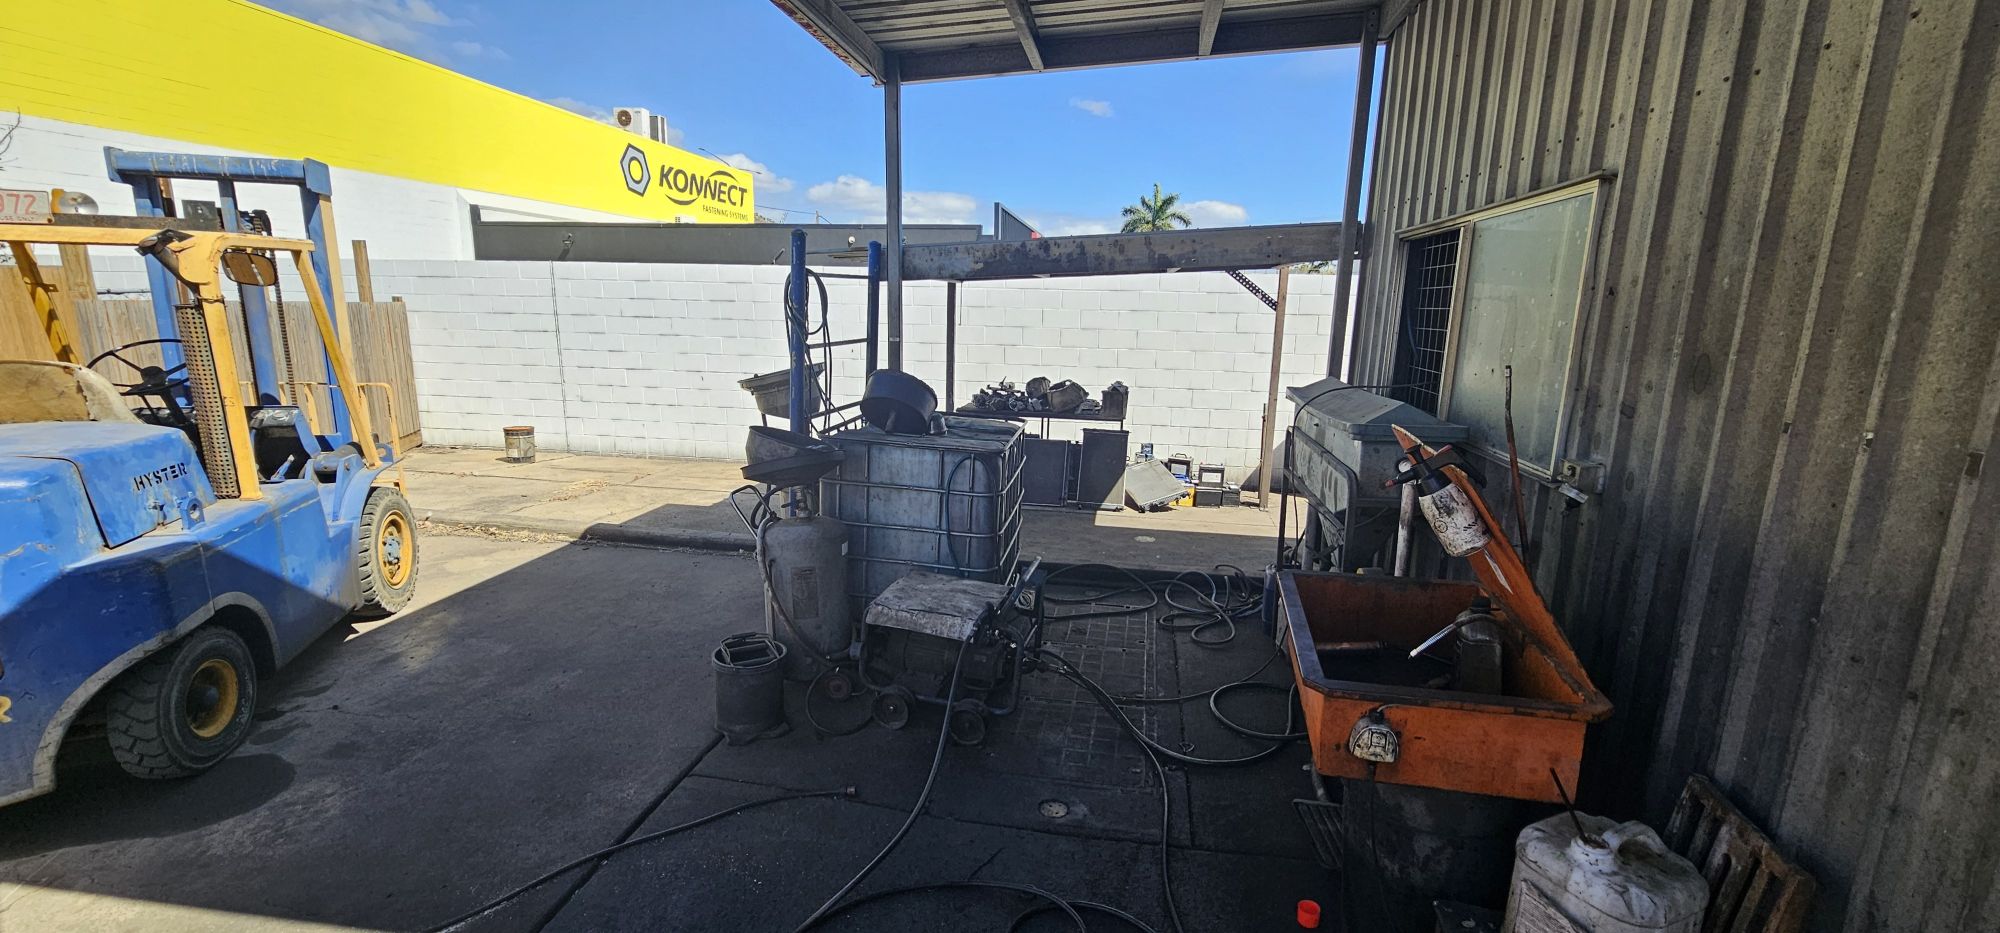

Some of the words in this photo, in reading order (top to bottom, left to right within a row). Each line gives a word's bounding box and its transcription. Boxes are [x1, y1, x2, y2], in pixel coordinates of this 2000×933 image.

[658, 164, 748, 208] KONNECT
[702, 204, 729, 218] FASTENING
[729, 210, 749, 222] SYSTEMS
[133, 462, 188, 491] HYSTER
